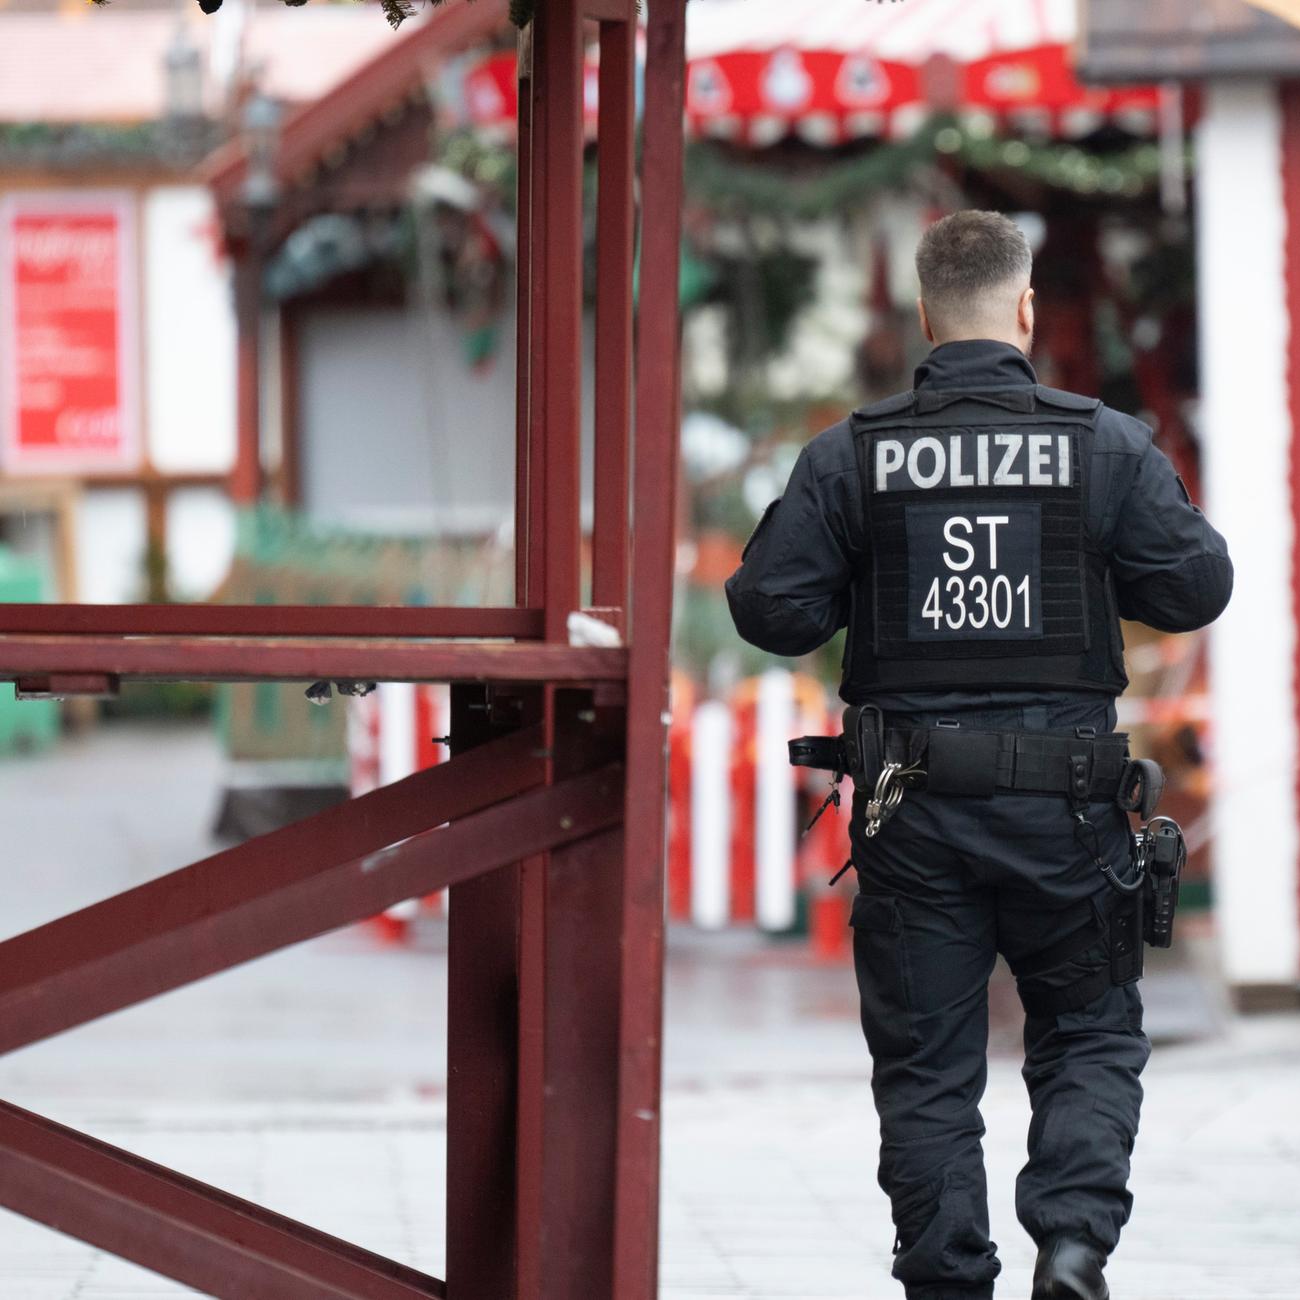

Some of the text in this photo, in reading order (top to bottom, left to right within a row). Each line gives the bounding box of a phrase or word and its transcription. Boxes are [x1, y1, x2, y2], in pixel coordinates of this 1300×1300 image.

[876, 433, 1070, 491] POLIZEI
[942, 516, 1009, 572] ST
[921, 574, 1030, 630] 43301
